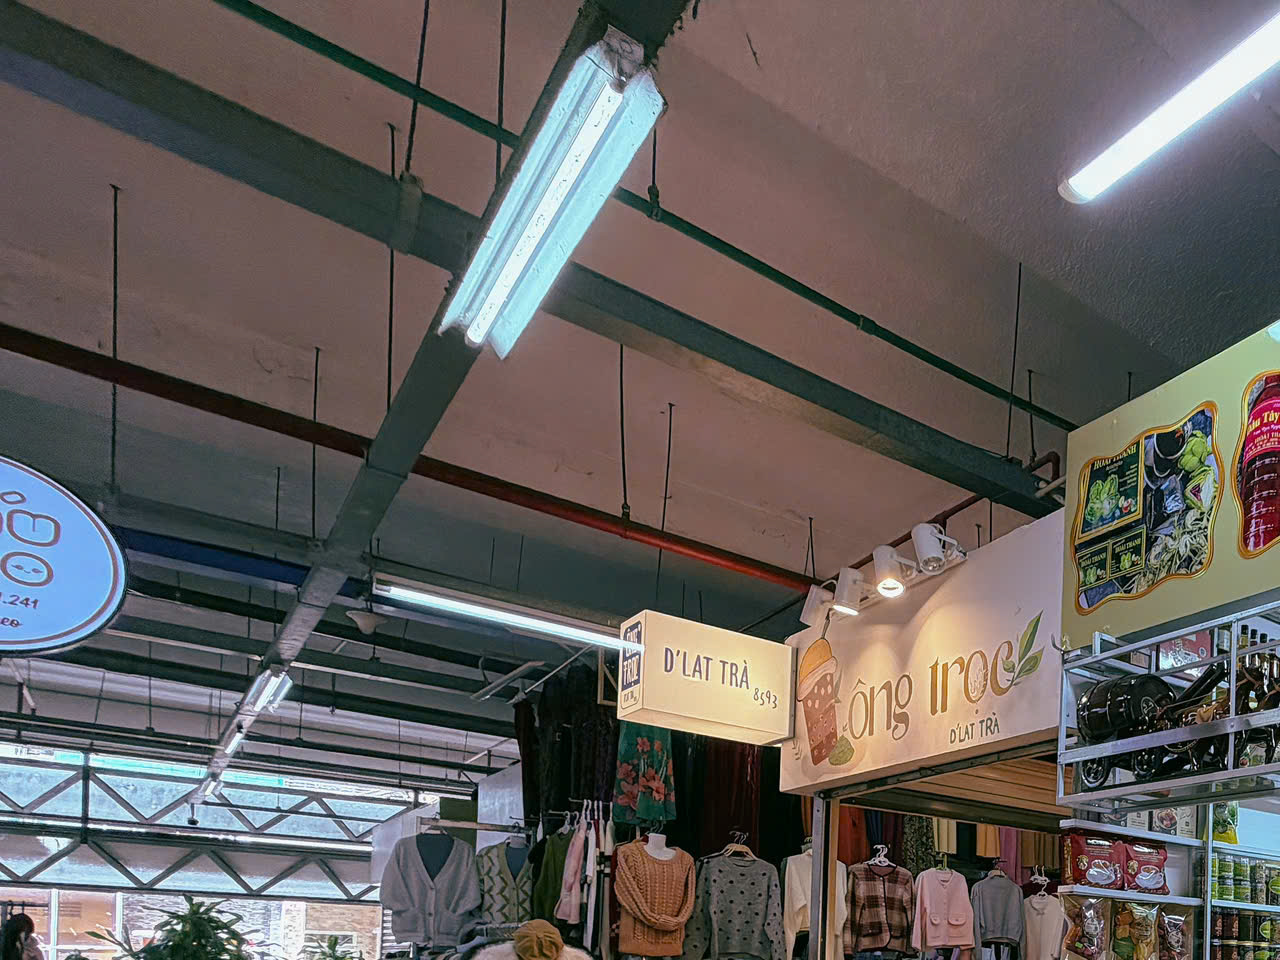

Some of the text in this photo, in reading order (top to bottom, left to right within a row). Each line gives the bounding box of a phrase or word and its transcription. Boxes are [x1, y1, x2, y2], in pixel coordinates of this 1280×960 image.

[664, 647, 750, 690] D'LAT TRÀ
[753, 687, 778, 709] 8593
[848, 673, 913, 741] ông
[949, 712, 1000, 744] D'LAT TRÀ
